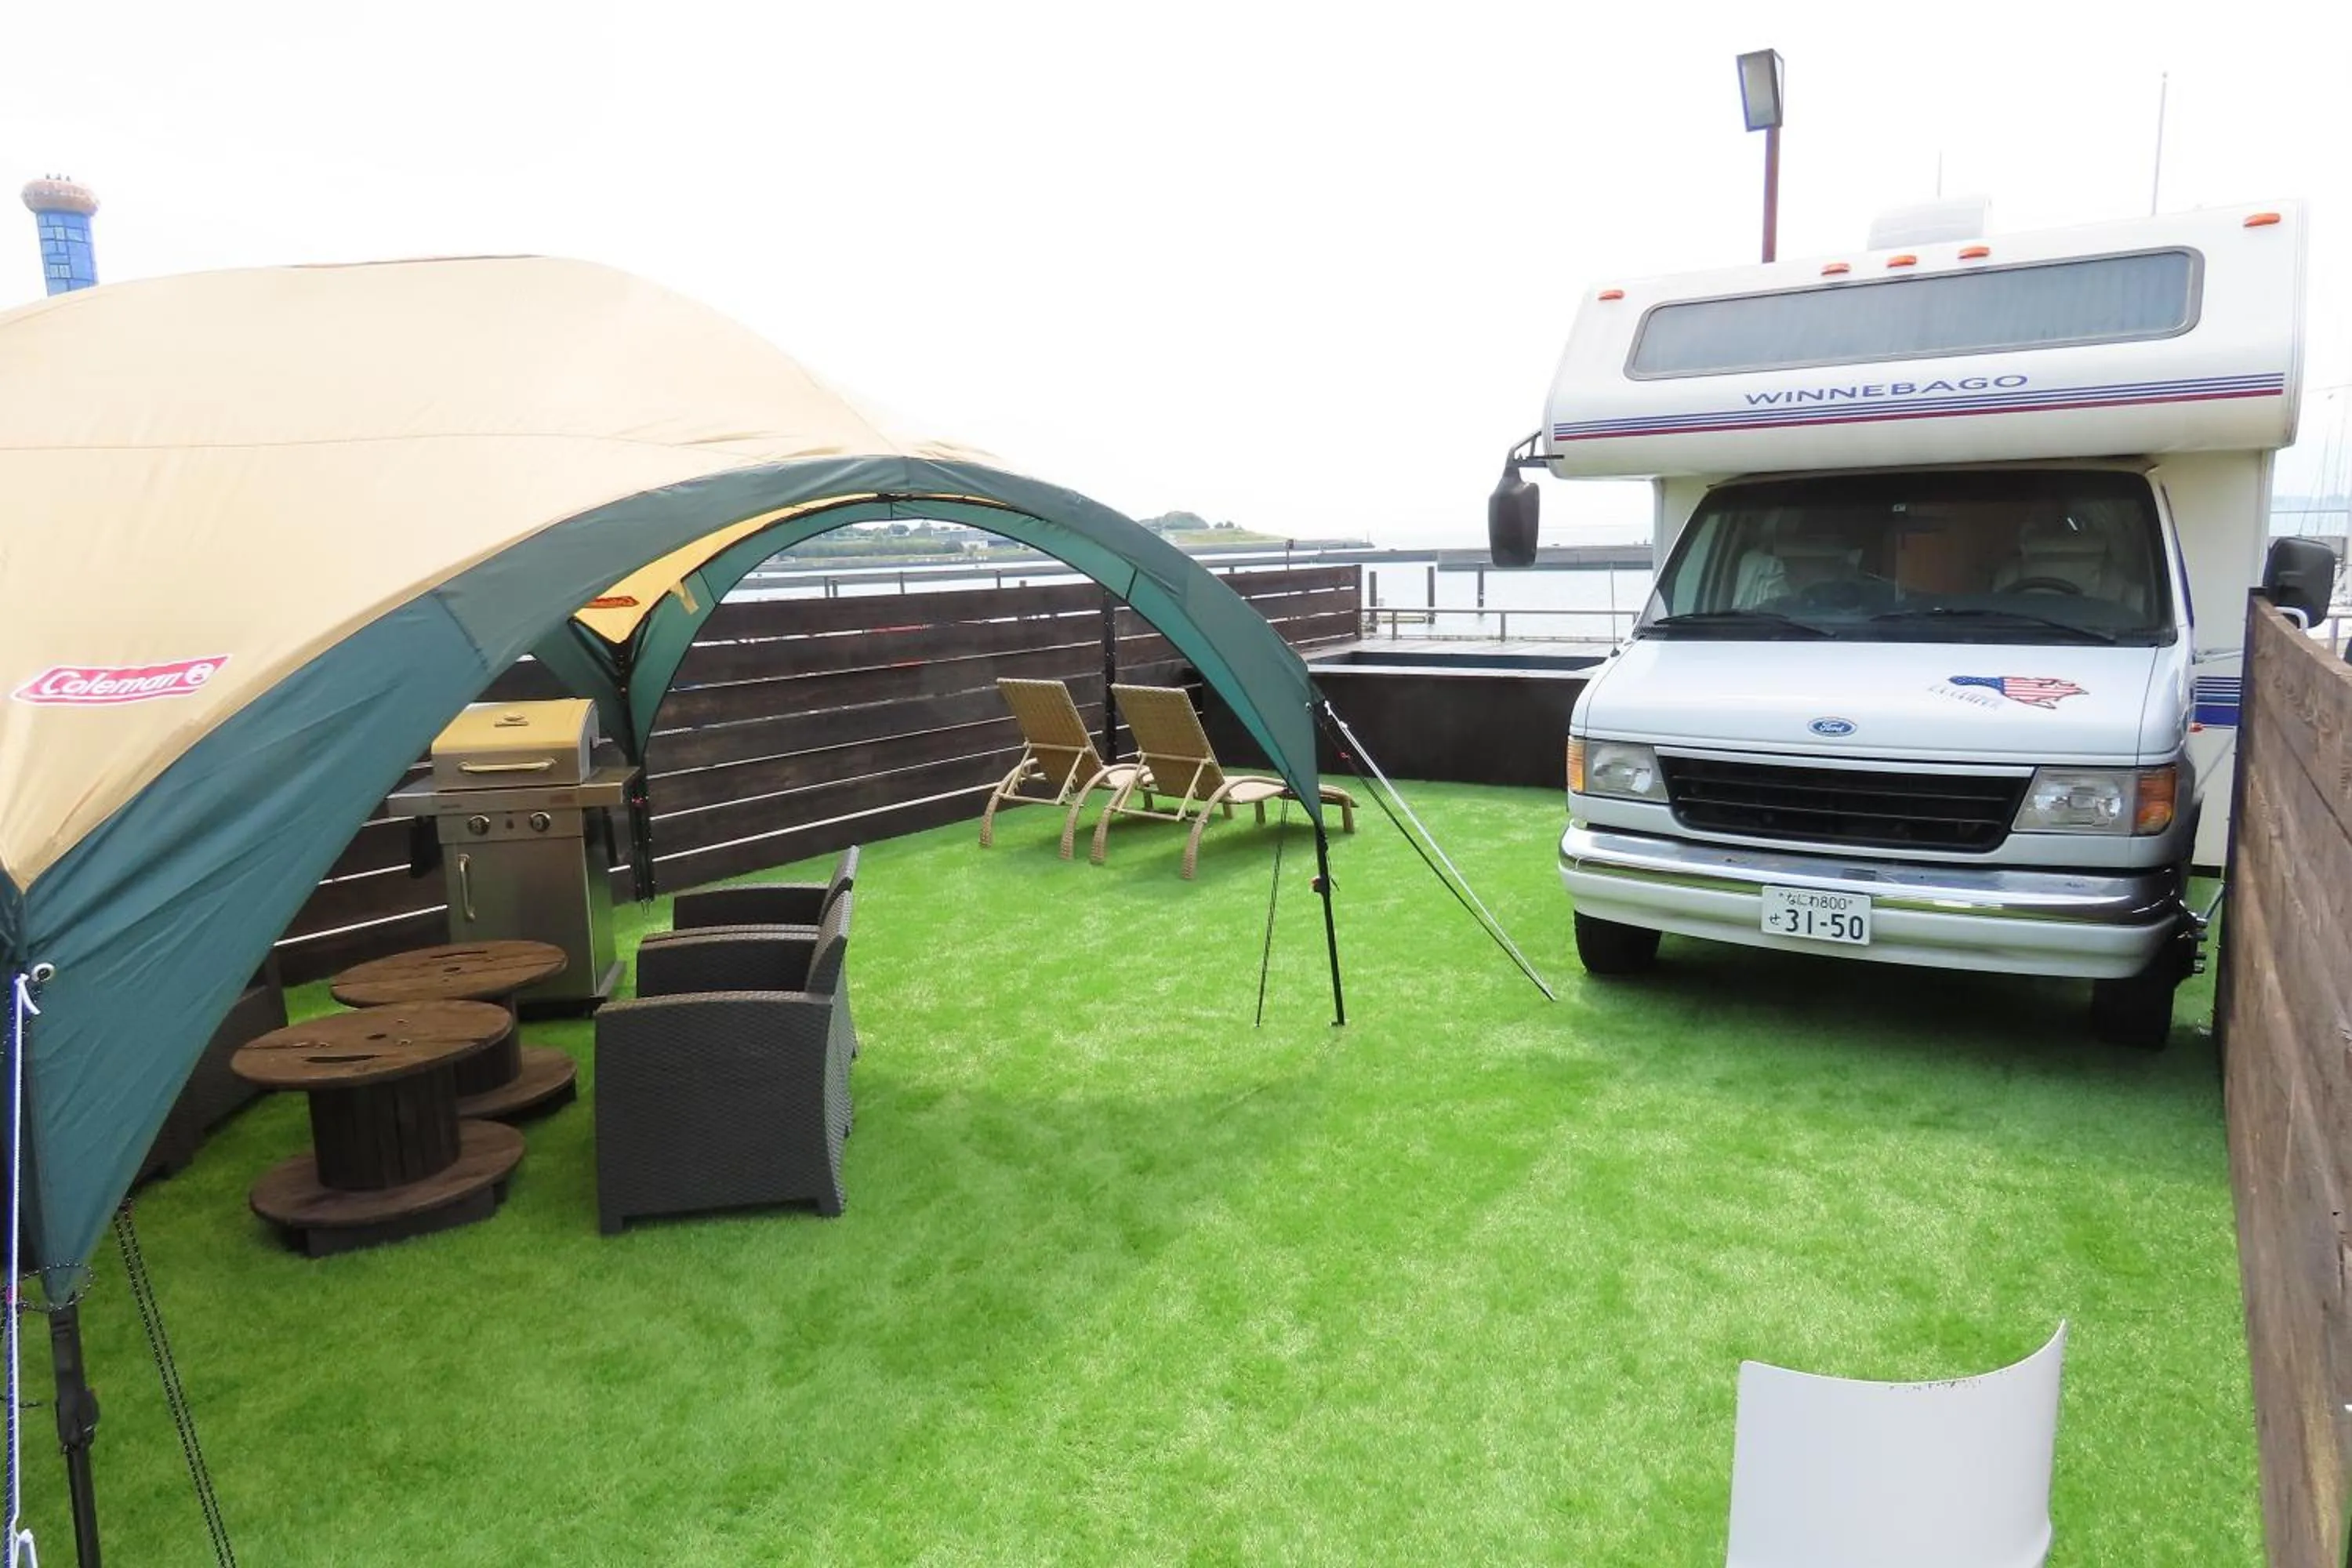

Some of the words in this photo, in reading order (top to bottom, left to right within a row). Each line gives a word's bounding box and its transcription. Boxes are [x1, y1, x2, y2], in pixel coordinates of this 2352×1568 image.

[1744, 375, 2028, 405] WINNEBAGO
[42, 670, 180, 695] Coleman
[1785, 909, 1864, 940] 31-50
